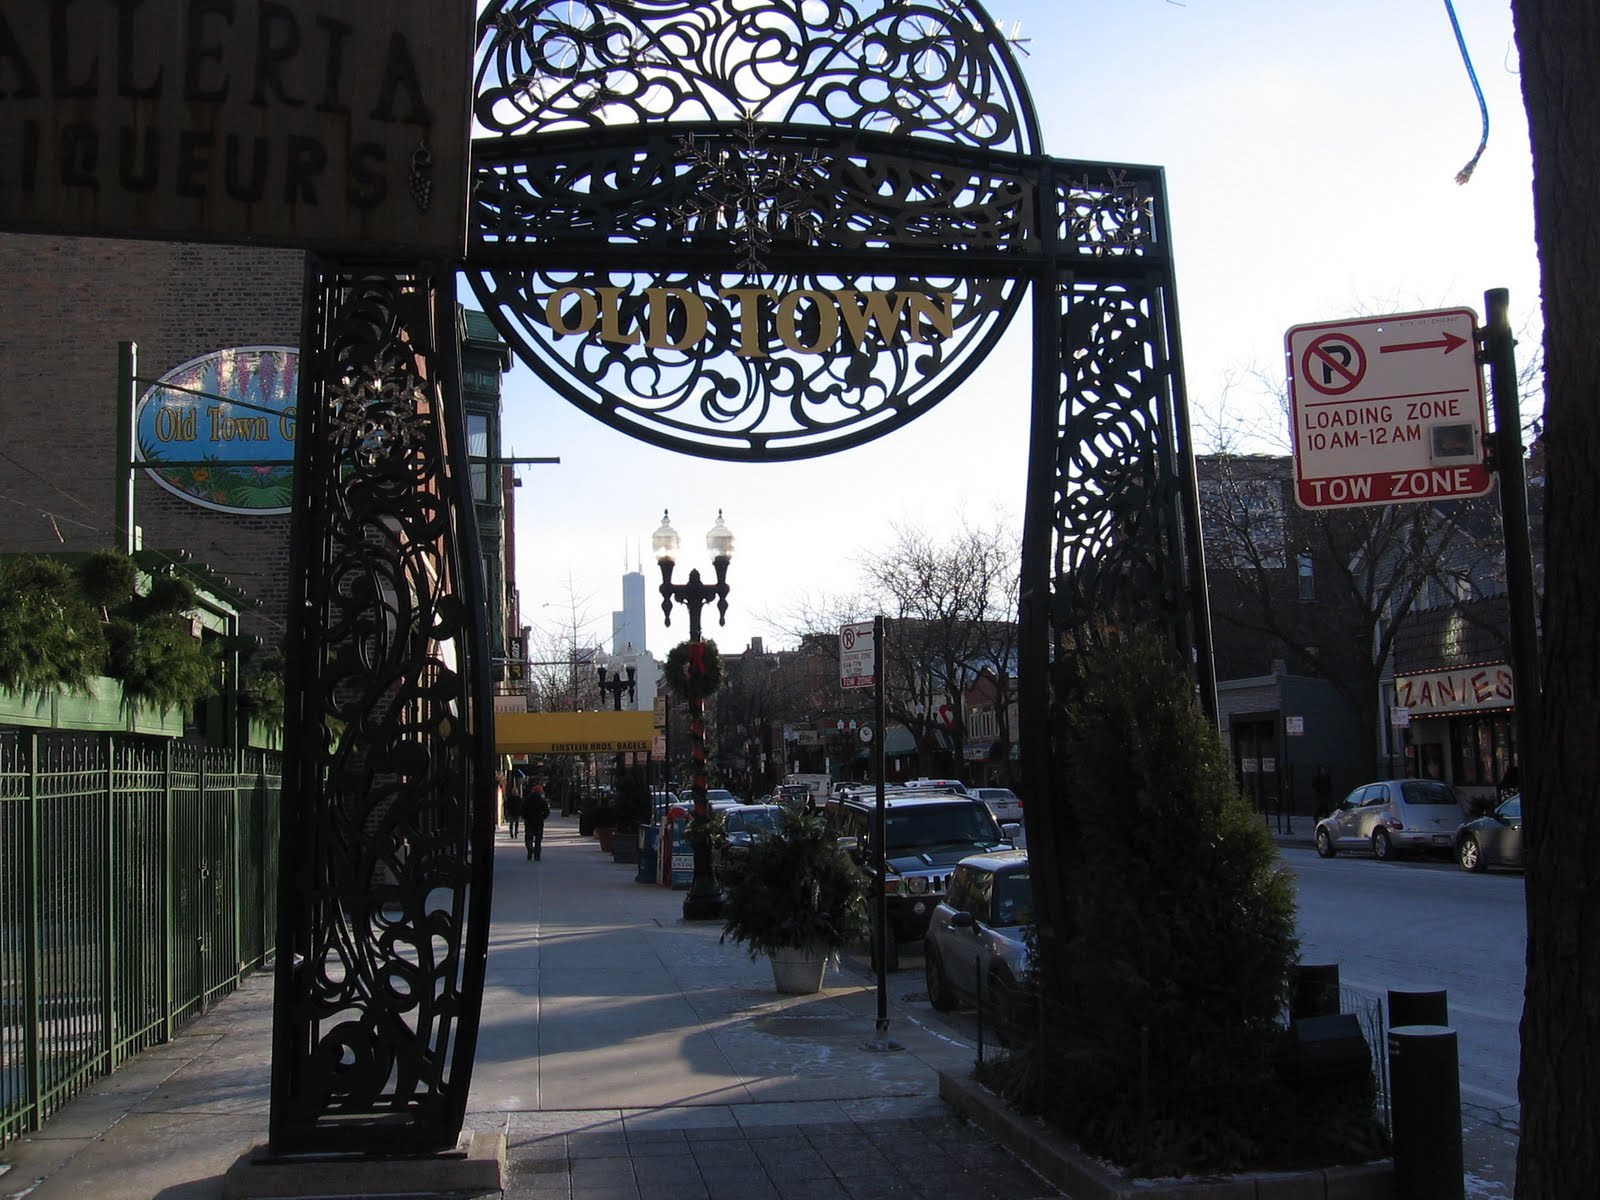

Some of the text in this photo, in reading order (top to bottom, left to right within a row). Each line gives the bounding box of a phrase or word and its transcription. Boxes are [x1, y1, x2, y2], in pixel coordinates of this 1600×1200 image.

[0, 118, 388, 211] IQUEURS
[545, 286, 958, 358] OLD TOWN
[155, 406, 198, 443] Old
[206, 405, 269, 442] Town
[1305, 399, 1461, 430] LOADING ZONE
[1310, 468, 1473, 503] TOW ZONE
[843, 676, 874, 687] TOW ZONE
[1399, 671, 1513, 709] ZANIES
[552, 743, 588, 752] EINSTEIN
[617, 741, 647, 750] BAGELS
